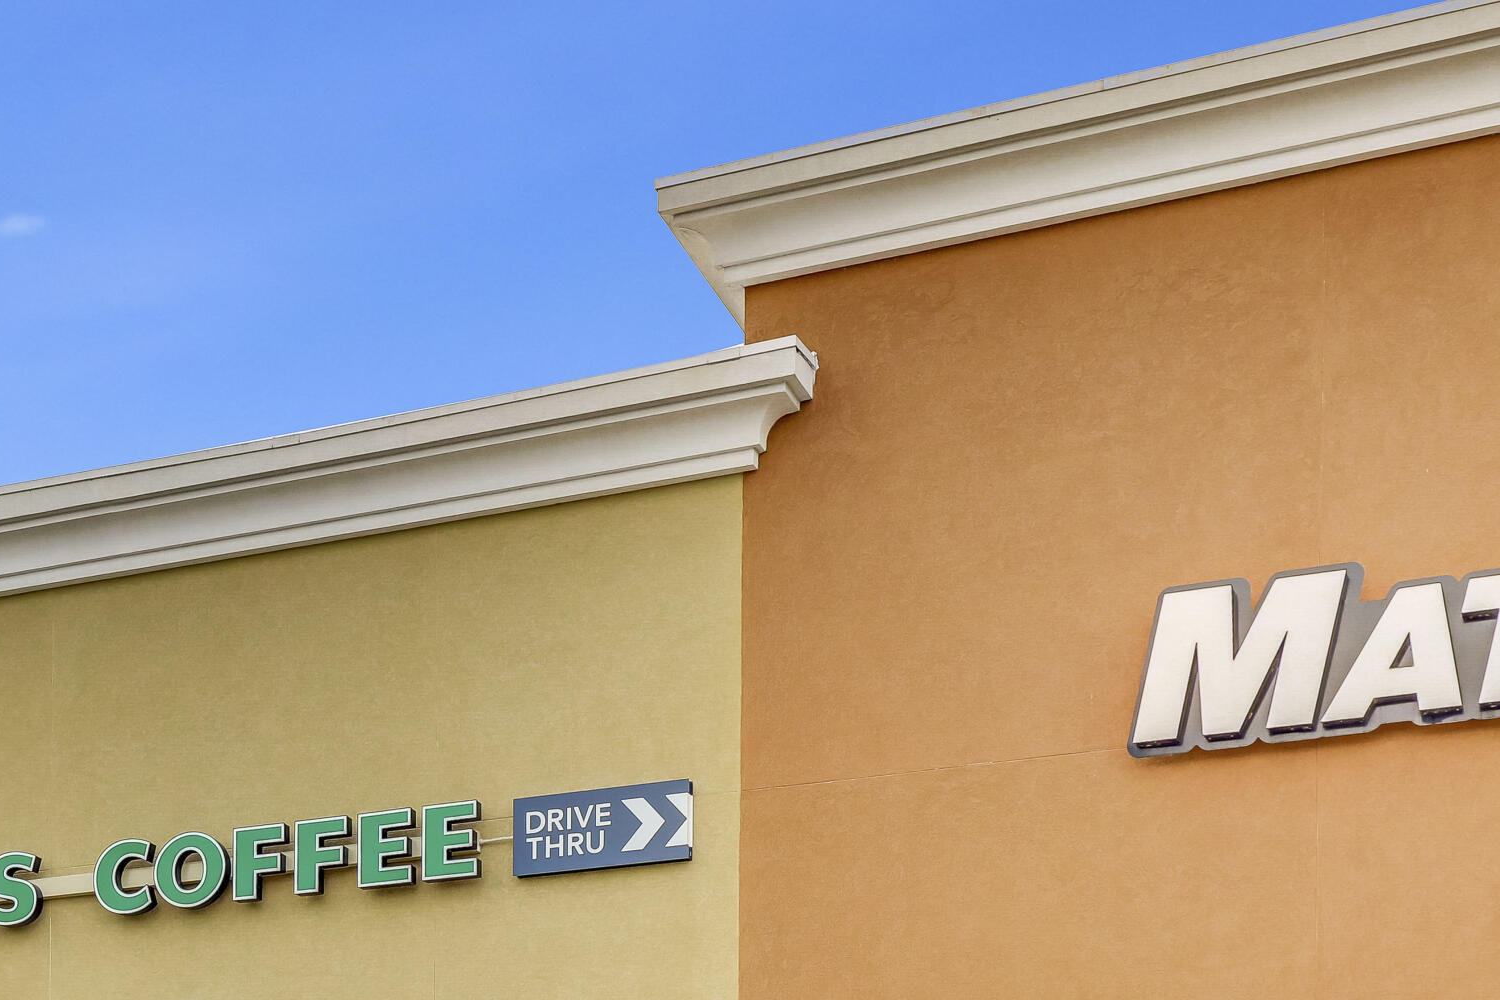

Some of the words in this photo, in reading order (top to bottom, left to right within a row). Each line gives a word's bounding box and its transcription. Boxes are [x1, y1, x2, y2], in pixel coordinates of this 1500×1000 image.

[1132, 568, 1500, 748] MA
[525, 802, 612, 835] DRIVE
[526, 829, 605, 860] THRU
[94, 799, 480, 915] COFFEE
